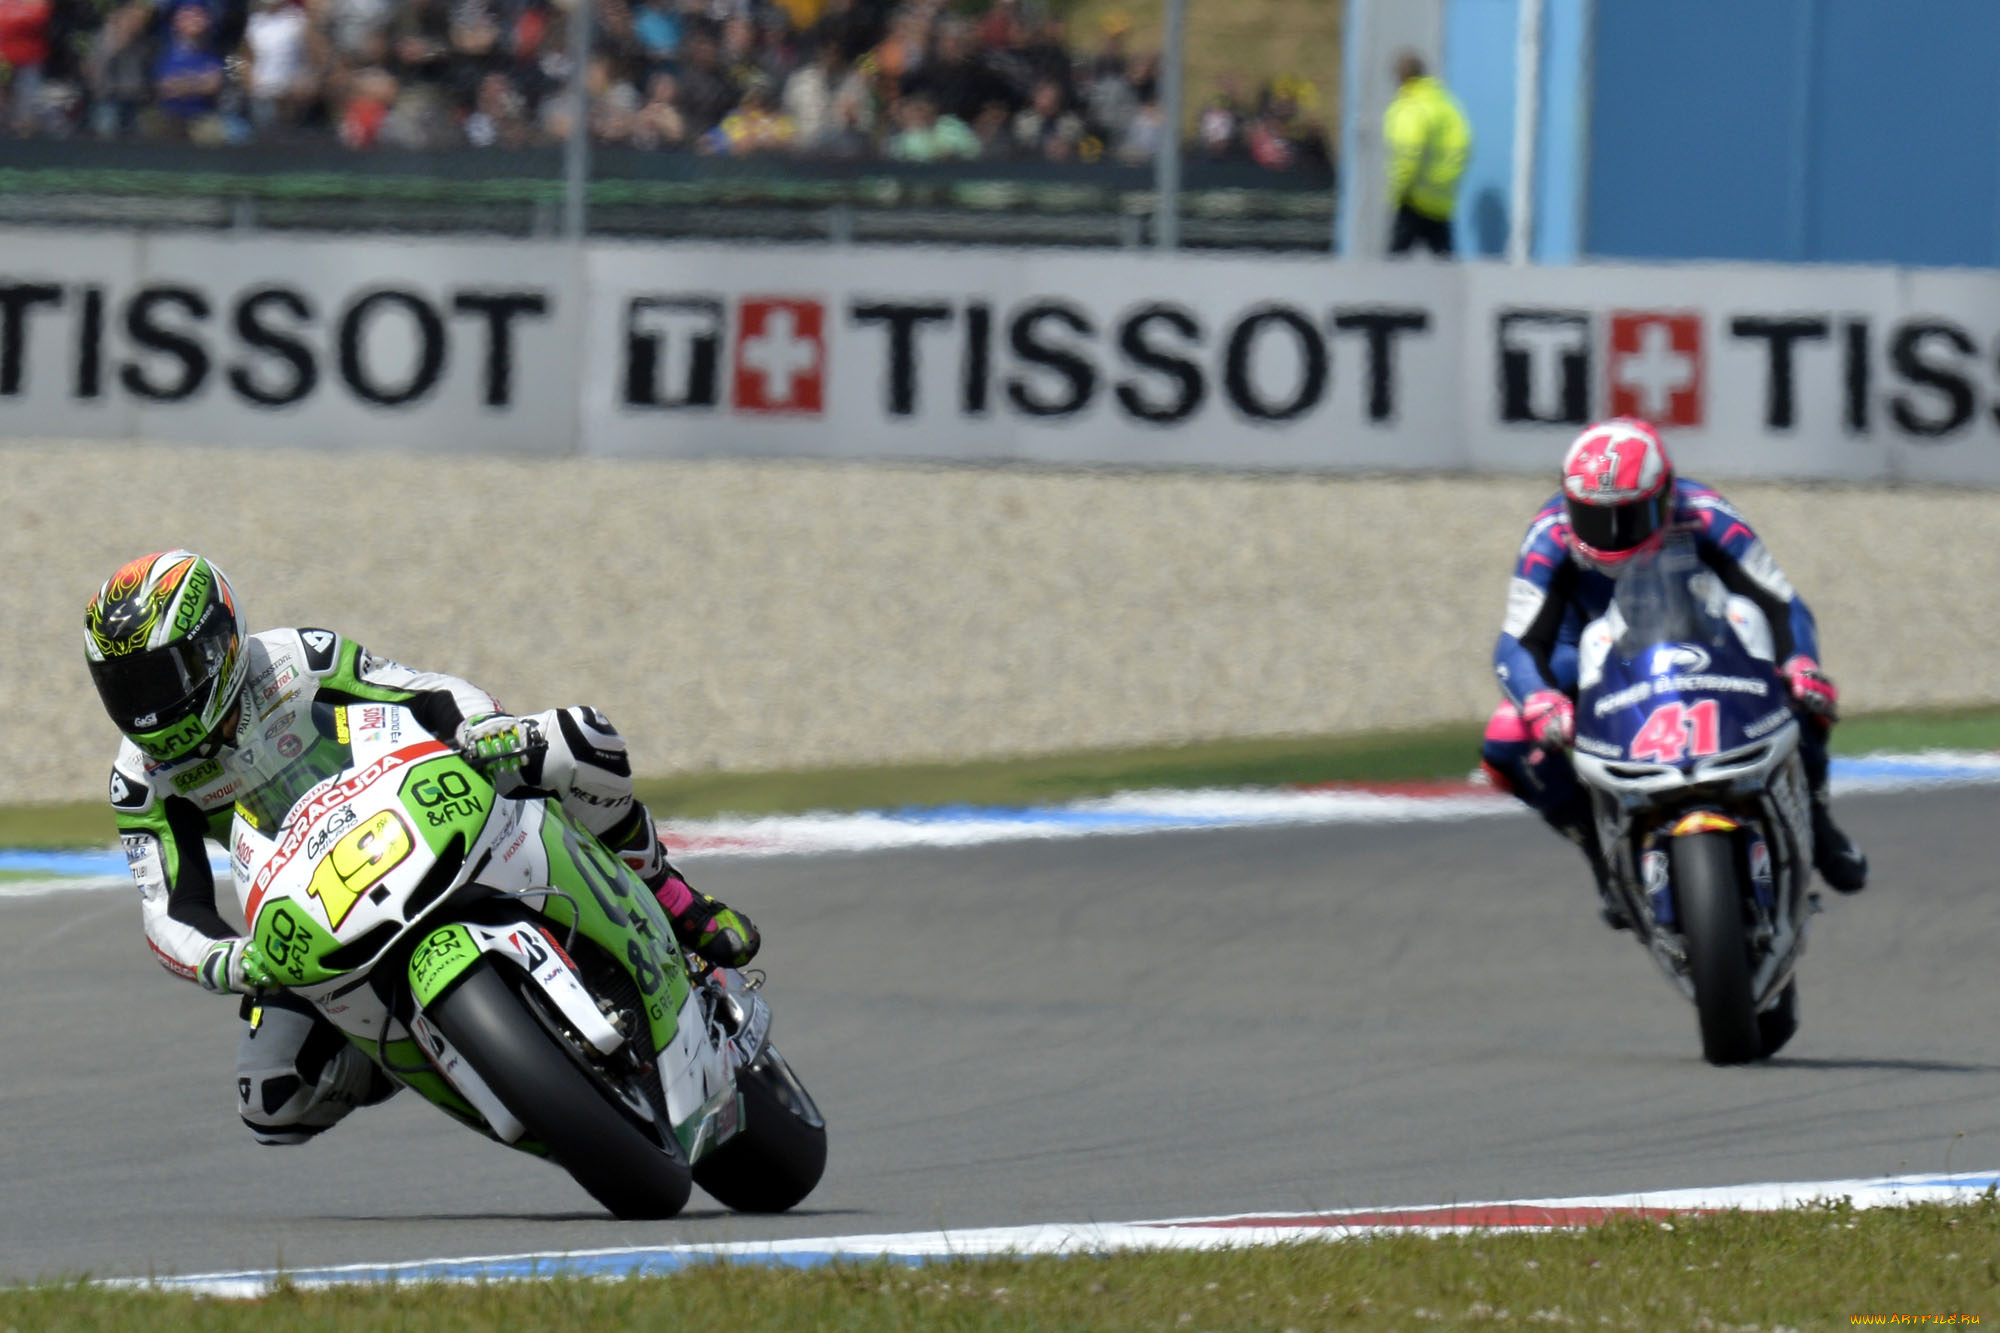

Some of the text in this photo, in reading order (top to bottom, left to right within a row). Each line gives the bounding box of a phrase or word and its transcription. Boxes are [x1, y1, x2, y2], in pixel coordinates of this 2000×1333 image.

[0, 284, 548, 406] TISSOT
[852, 300, 1430, 424] TISSOT
[1730, 316, 2000, 436] TIS
[175, 569, 210, 632] GO&FUN
[262, 671, 293, 700] Castrol
[1629, 698, 1719, 764] 41
[288, 782, 332, 823] HONDA
[410, 770, 472, 808] GO
[426, 796, 484, 827] &FUN
[256, 756, 404, 892] BARRACUDA
[319, 819, 358, 855] MILANO
[503, 830, 528, 862] HONDA
[306, 808, 416, 934] 19
[265, 908, 296, 967] GO
[288, 925, 313, 981] &FUN
[411, 929, 457, 972] GO
[416, 939, 462, 983] &FUN
